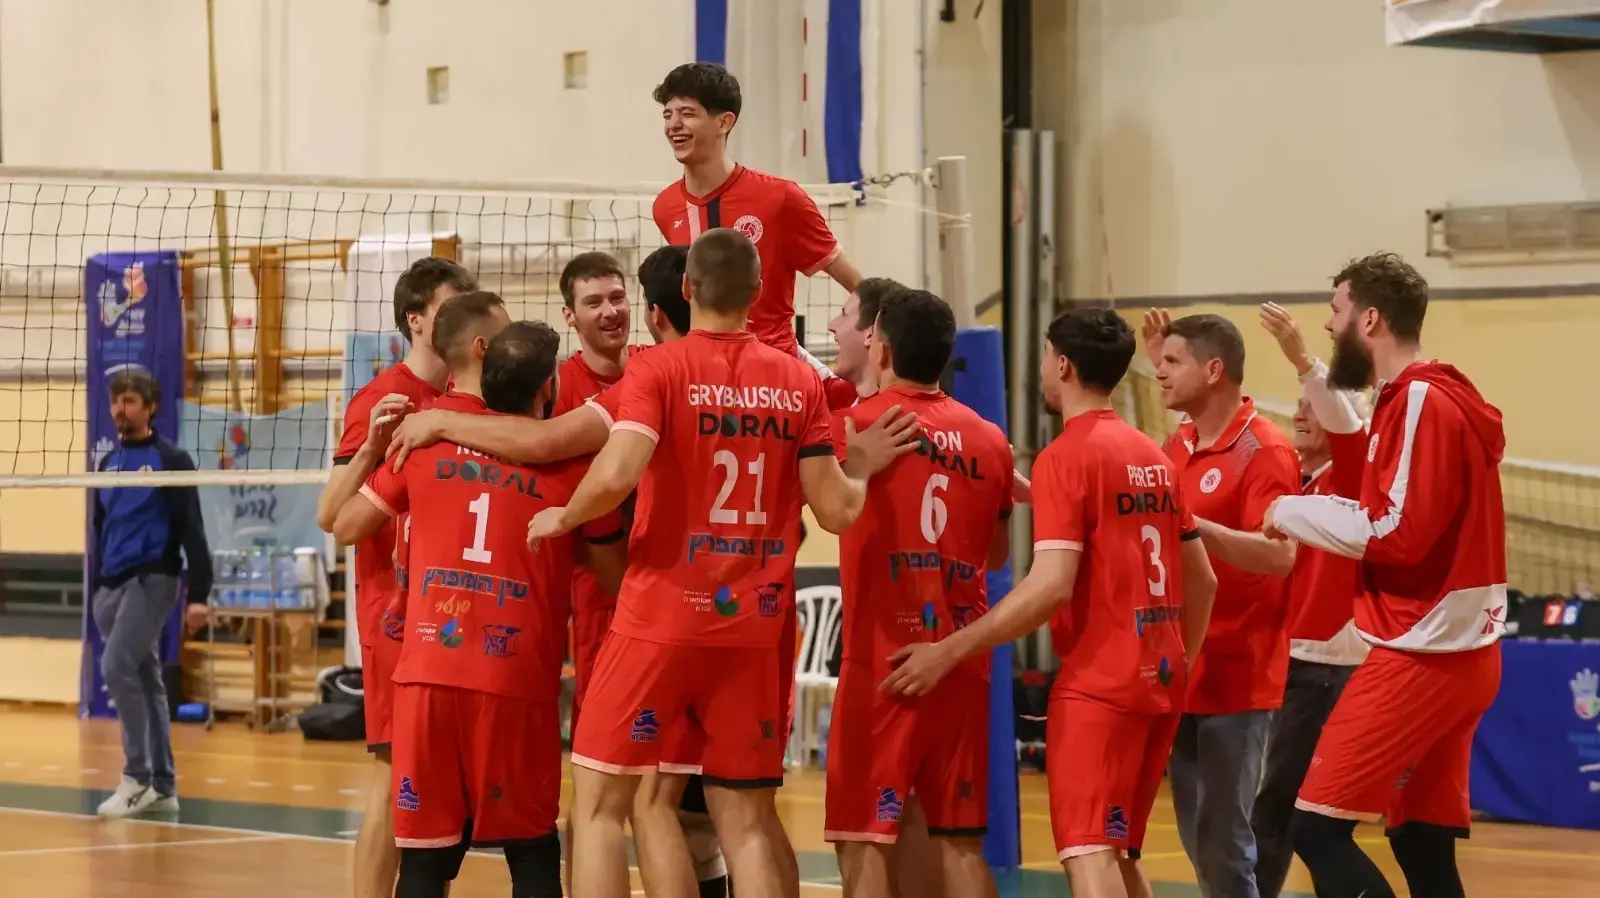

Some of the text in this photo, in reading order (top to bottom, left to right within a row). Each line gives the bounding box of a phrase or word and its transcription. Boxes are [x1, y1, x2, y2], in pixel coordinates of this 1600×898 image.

[688, 384, 803, 413] GRYBAUSKAS
[699, 412, 796, 441] DORAL
[914, 435, 985, 480] ORAL
[436, 459, 544, 500] DORAL
[709, 449, 767, 525] 21
[1126, 464, 1171, 488] PERETZ
[920, 473, 949, 544] 6
[462, 492, 492, 564] 1
[1141, 524, 1167, 597] 3
[421, 568, 493, 596] המפרץ
[497, 578, 528, 607] עין
[1547, 604, 1563, 625] 7
